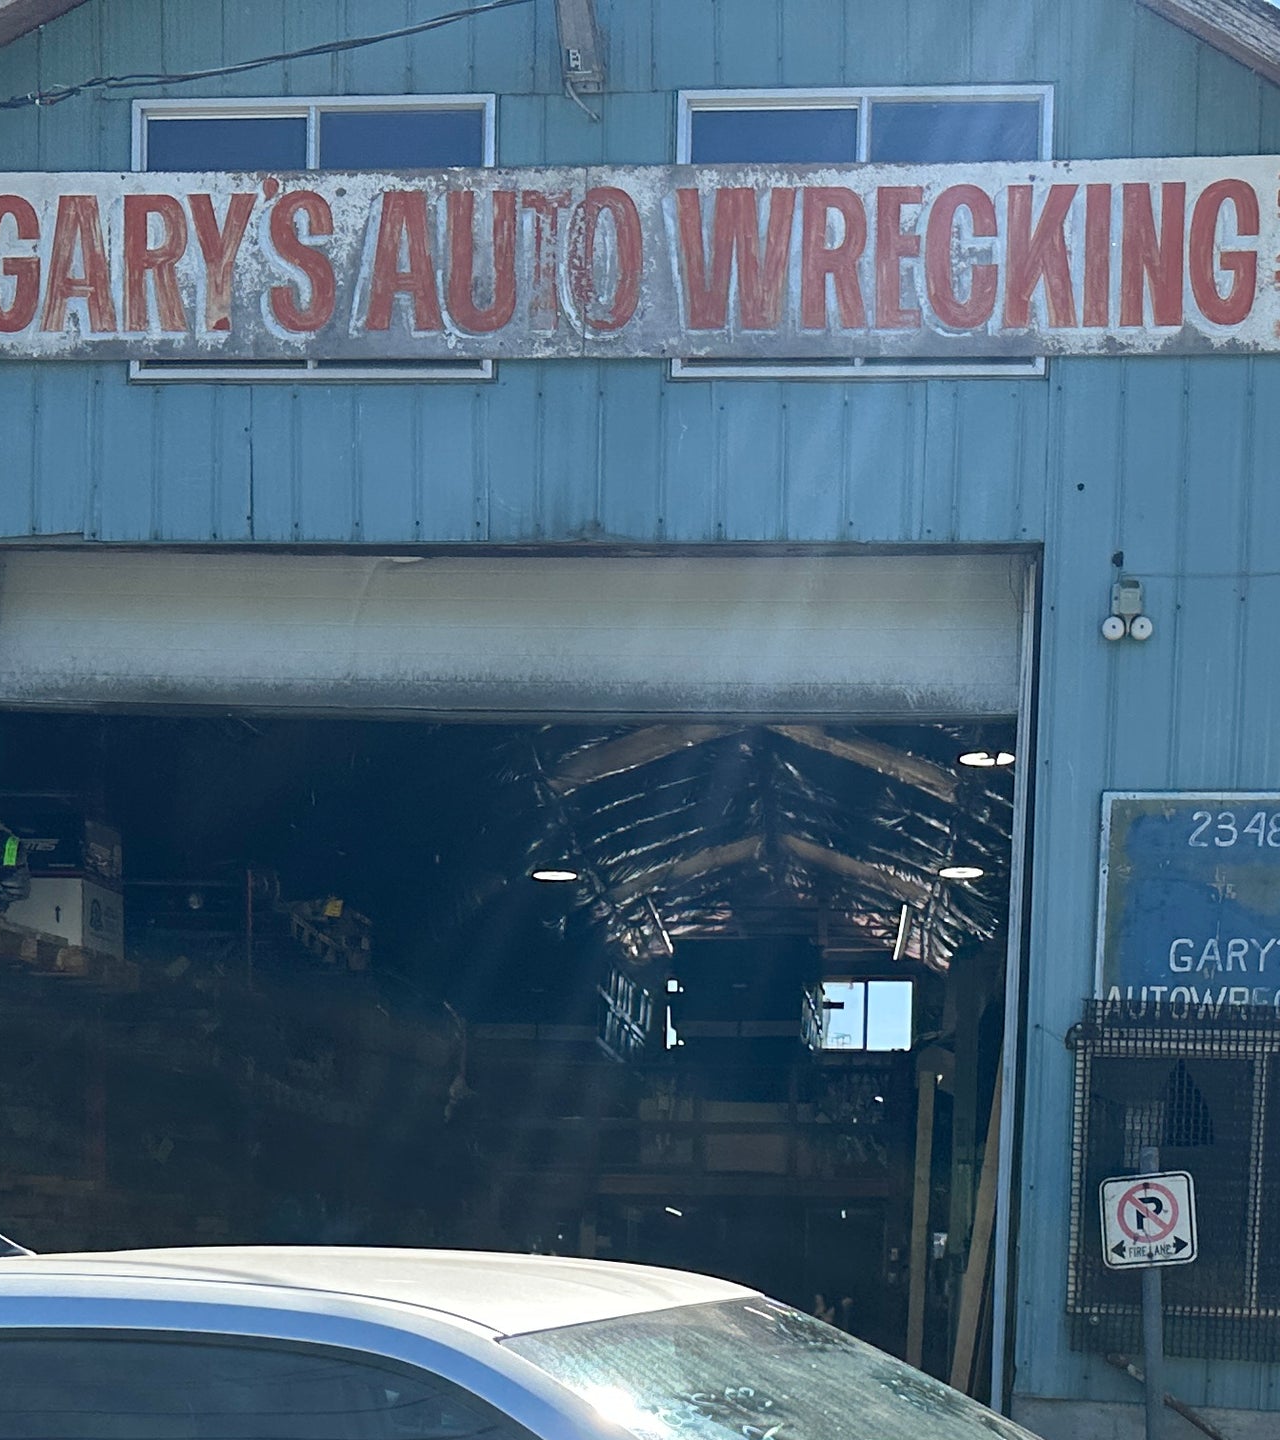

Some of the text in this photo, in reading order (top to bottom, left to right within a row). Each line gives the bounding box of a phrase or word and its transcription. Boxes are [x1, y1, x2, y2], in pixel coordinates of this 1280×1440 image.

[365, 186, 642, 332] AUTO
[675, 178, 1261, 331] WRECKING
[1129, 1246, 1147, 1258] FIRE
